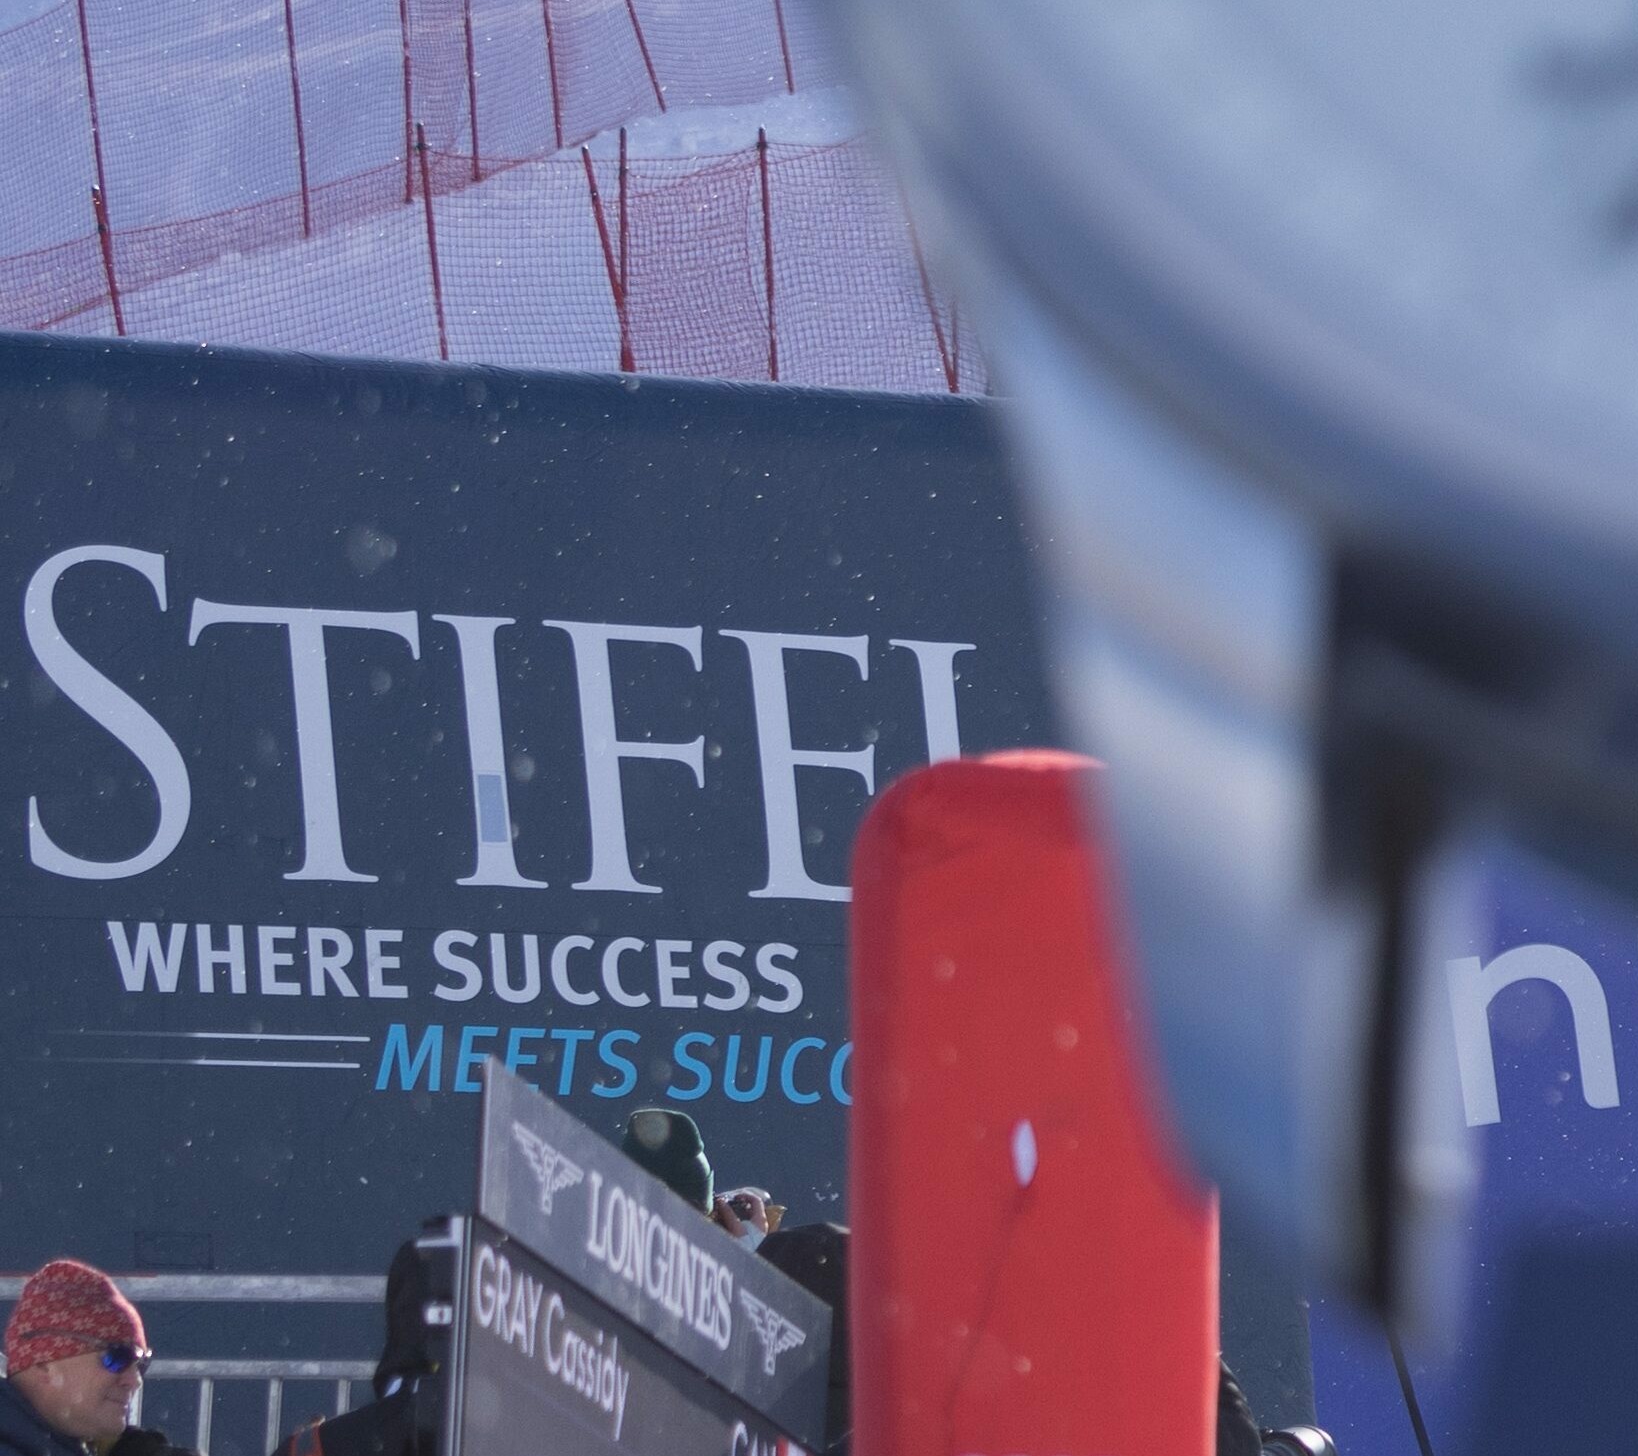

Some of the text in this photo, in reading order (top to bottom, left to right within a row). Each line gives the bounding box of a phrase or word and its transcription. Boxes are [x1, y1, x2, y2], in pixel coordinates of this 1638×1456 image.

[107, 919, 803, 1013] WHERE SUCCESS
[375, 1023, 639, 1098] MEETS
[587, 1171, 734, 1350] LONGINES
[472, 1245, 630, 1442] GRAY Cassidy
